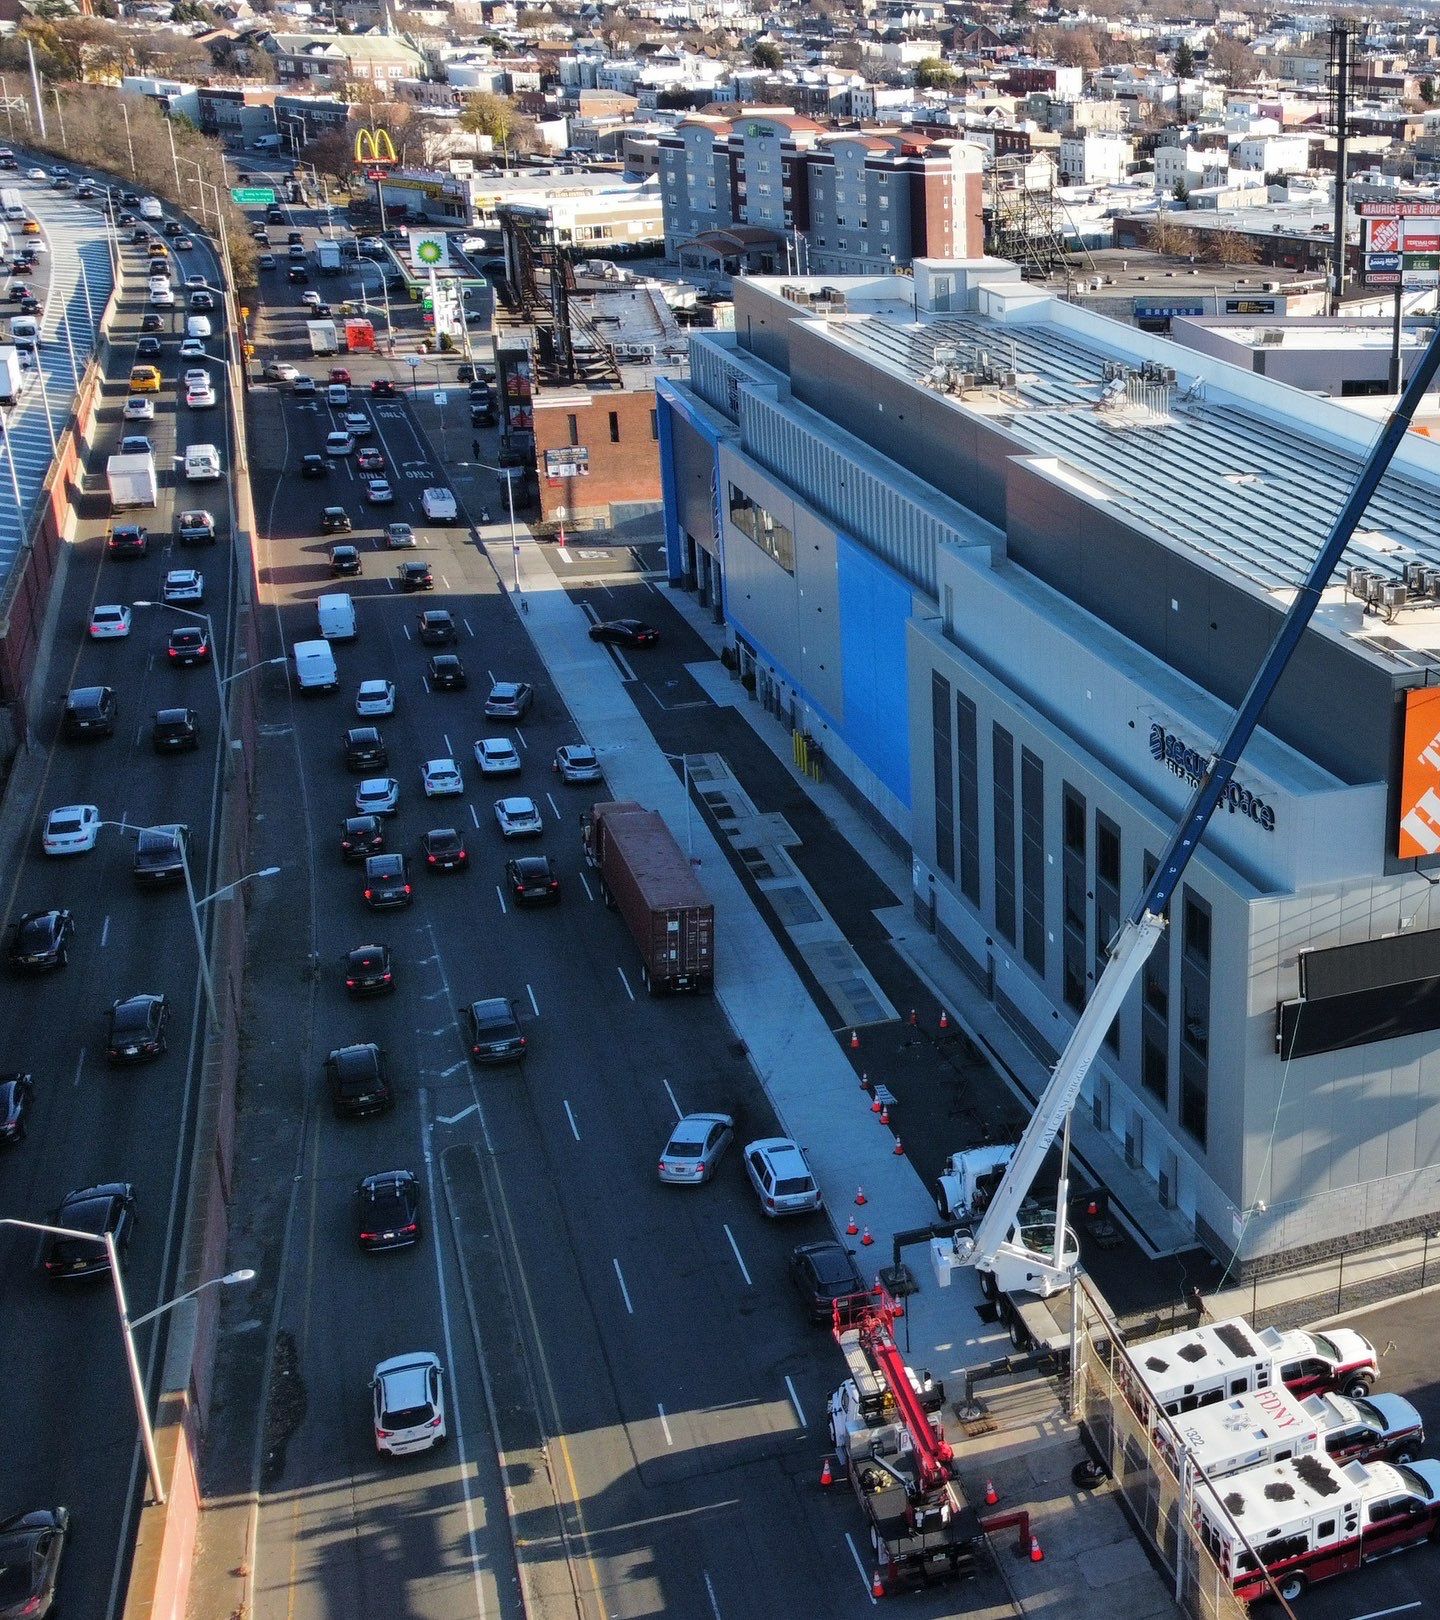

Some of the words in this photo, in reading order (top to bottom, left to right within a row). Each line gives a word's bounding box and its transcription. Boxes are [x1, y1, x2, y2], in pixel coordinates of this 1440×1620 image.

[1363, 204, 1400, 215] MAURICE
[1402, 204, 1418, 214] AVE
[405, 471, 435, 479] ONLY
[1253, 1389, 1304, 1429] FDNY
[1183, 1425, 1206, 1448] 1322
